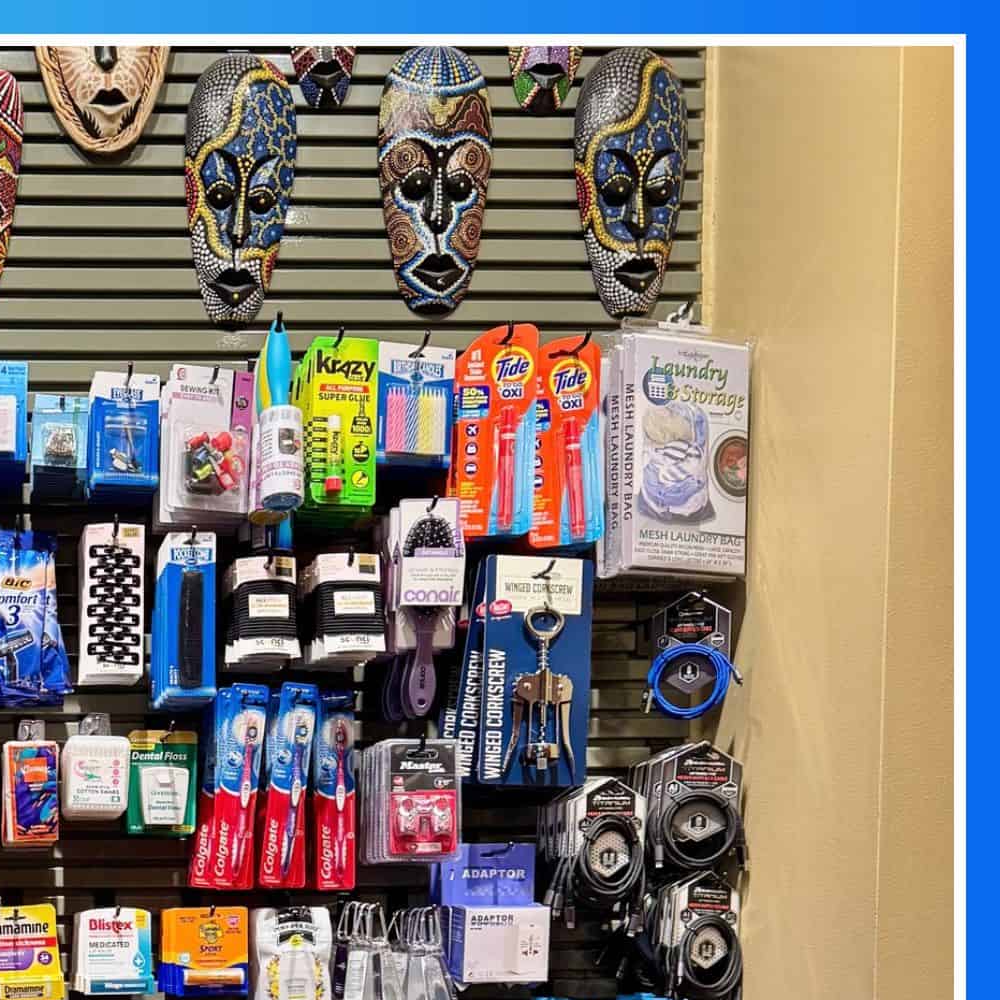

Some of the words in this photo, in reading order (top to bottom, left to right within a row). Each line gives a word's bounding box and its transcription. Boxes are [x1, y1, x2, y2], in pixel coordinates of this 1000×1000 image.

[495, 356, 531, 382] Tide
[553, 367, 588, 393] Tide
[650, 355, 731, 390] Laundry
[318, 392, 347, 401] SUPER
[349, 394, 370, 402] GLUE
[502, 387, 523, 399] OXI
[624, 383, 634, 422] MESH
[624, 424, 634, 492] LAUNDRY
[624, 493, 634, 521] BAG
[639, 529, 669, 541] MESH
[670, 531, 719, 545] LAUNDRY
[720, 535, 742, 547] BAG
[404, 587, 462, 602] conair
[504, 582, 533, 594] WINGED
[486, 649, 507, 724] CORKSCREW
[132, 751, 163, 761] Dental
[164, 751, 188, 761] Floss
[484, 725, 502, 779] WINGED
[214, 822, 230, 877] Colgate
[264, 818, 280, 874] Colgate
[462, 868, 526, 880] ADAPTOR
[470, 914, 514, 923] ADAPTOR
